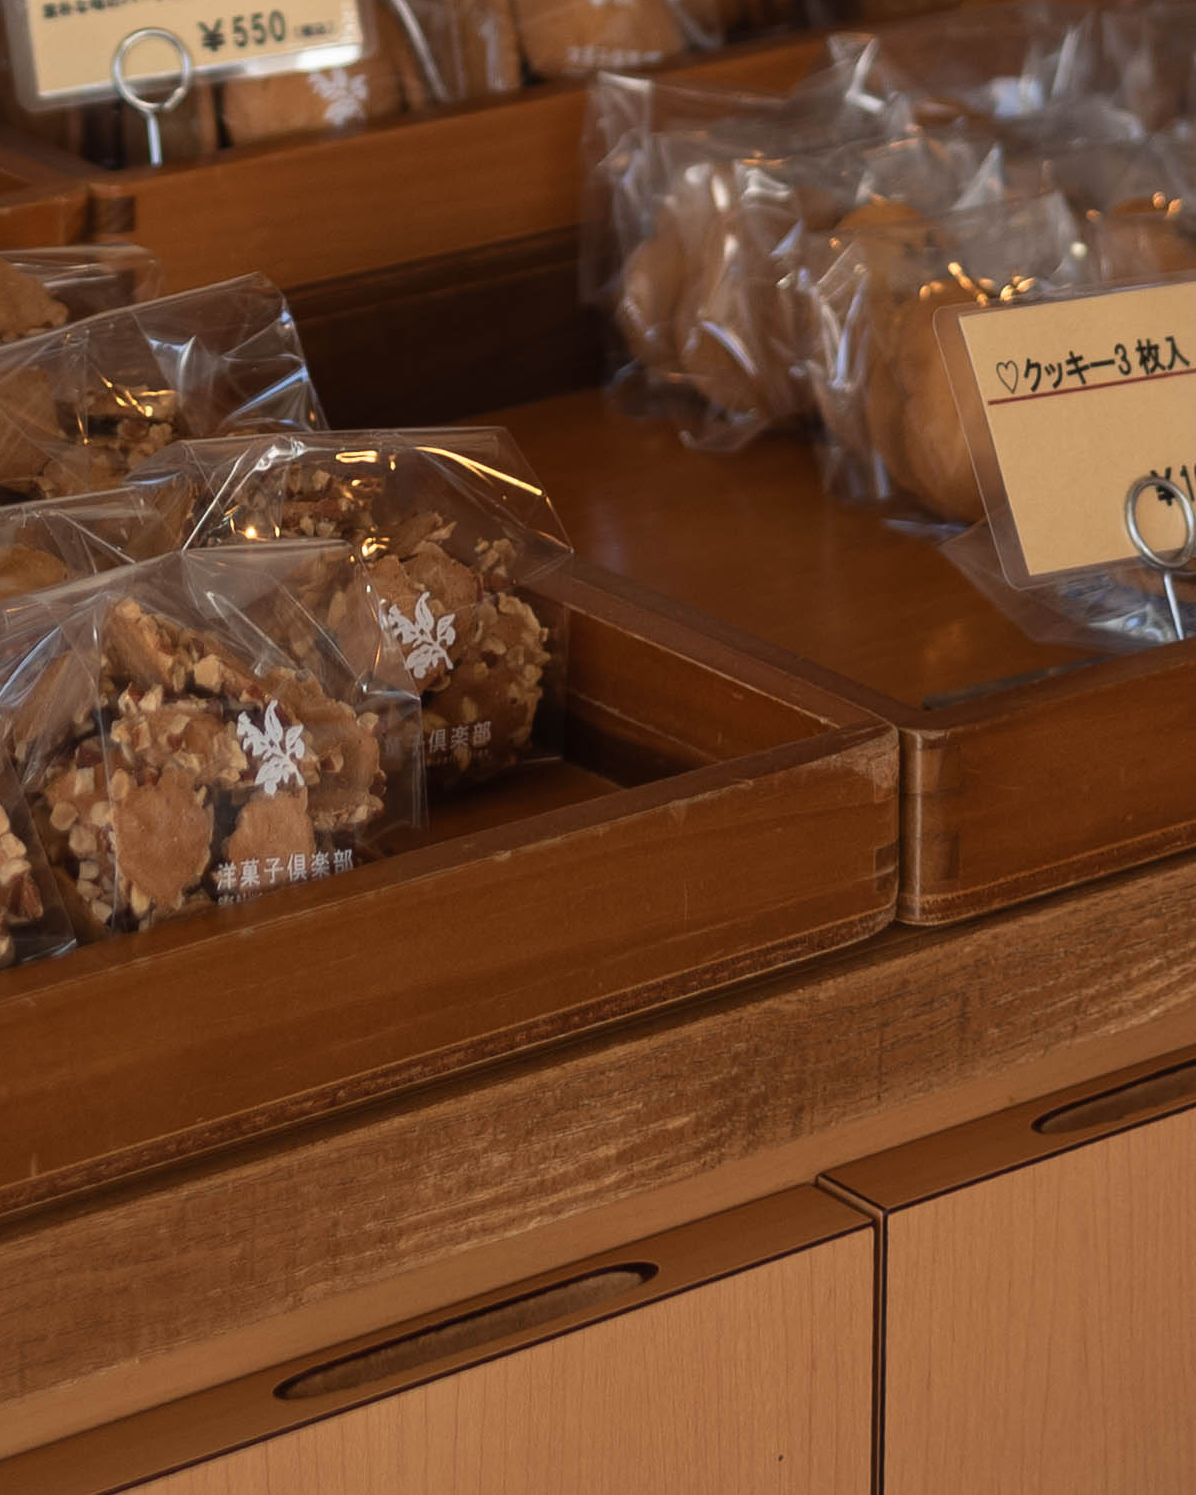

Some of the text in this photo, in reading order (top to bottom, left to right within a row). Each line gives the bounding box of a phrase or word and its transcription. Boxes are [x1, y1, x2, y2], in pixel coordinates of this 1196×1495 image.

[198, 9, 287, 52] ¥550
[216, 848, 355, 891] 洋菓子倶楽部
